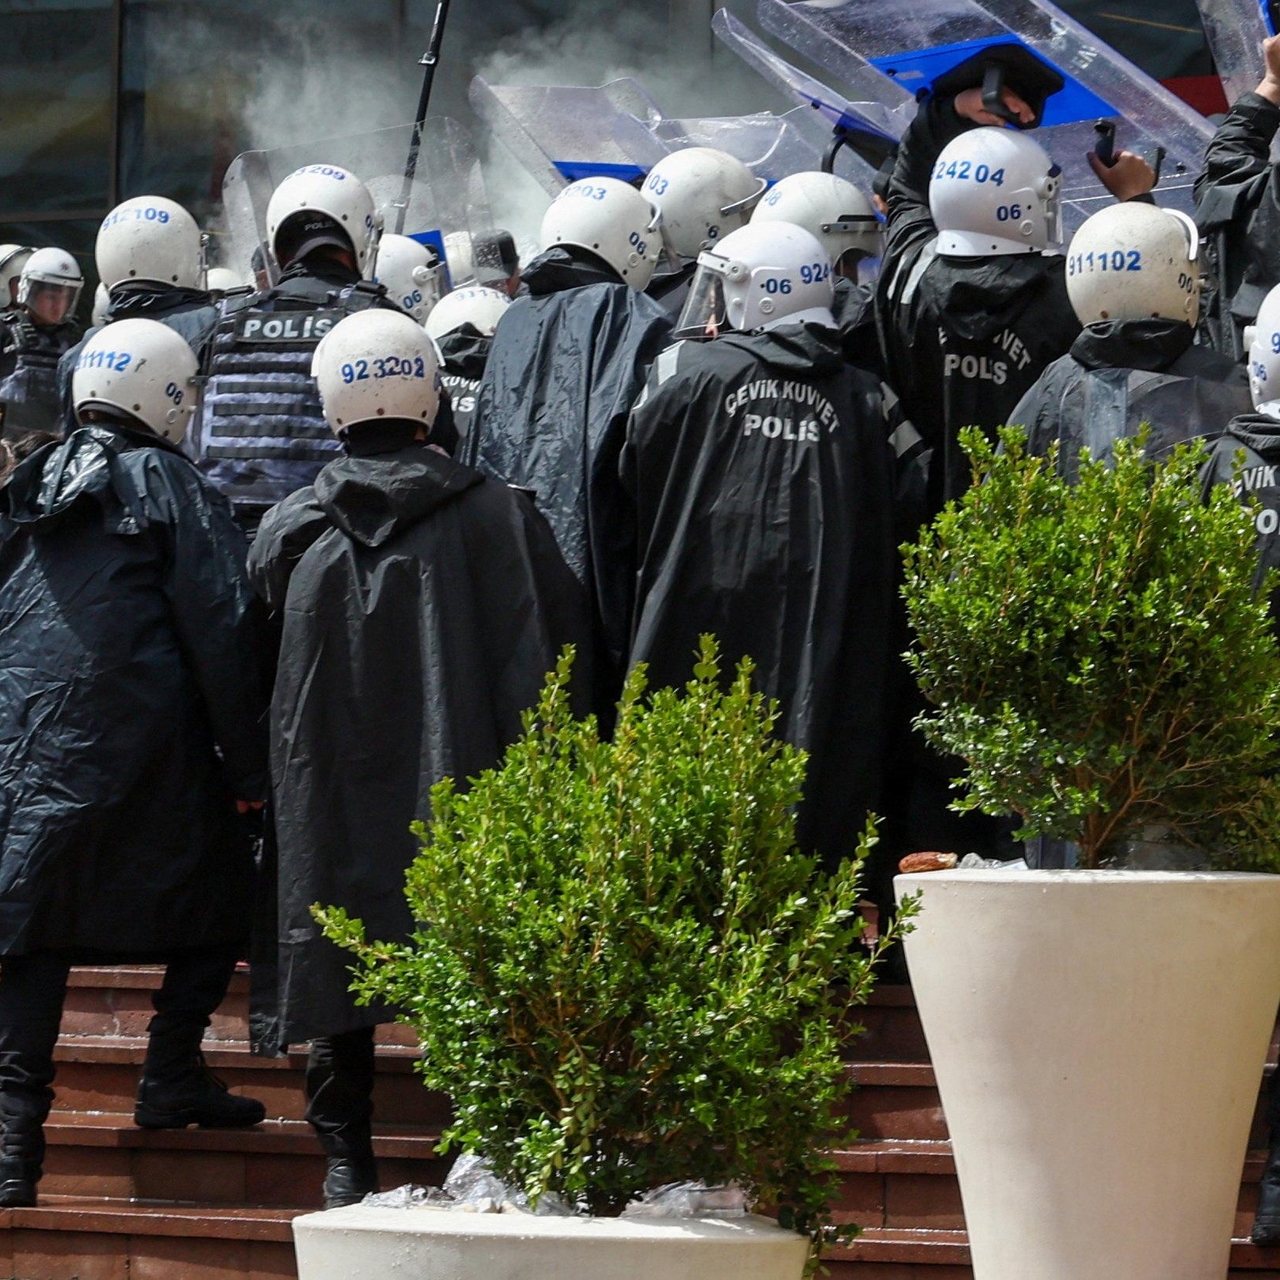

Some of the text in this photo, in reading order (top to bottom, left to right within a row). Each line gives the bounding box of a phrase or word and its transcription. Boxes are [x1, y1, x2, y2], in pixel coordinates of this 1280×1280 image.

[996, 203, 1022, 222] 06
[629, 230, 648, 256] 06
[765, 278, 792, 295] 06
[403, 289, 423, 310] 06
[243, 315, 333, 339] POLİS
[944, 353, 1008, 385] POLS
[725, 378, 841, 434] ÇEVİK KUVVET
[743, 413, 821, 442] POLİS
